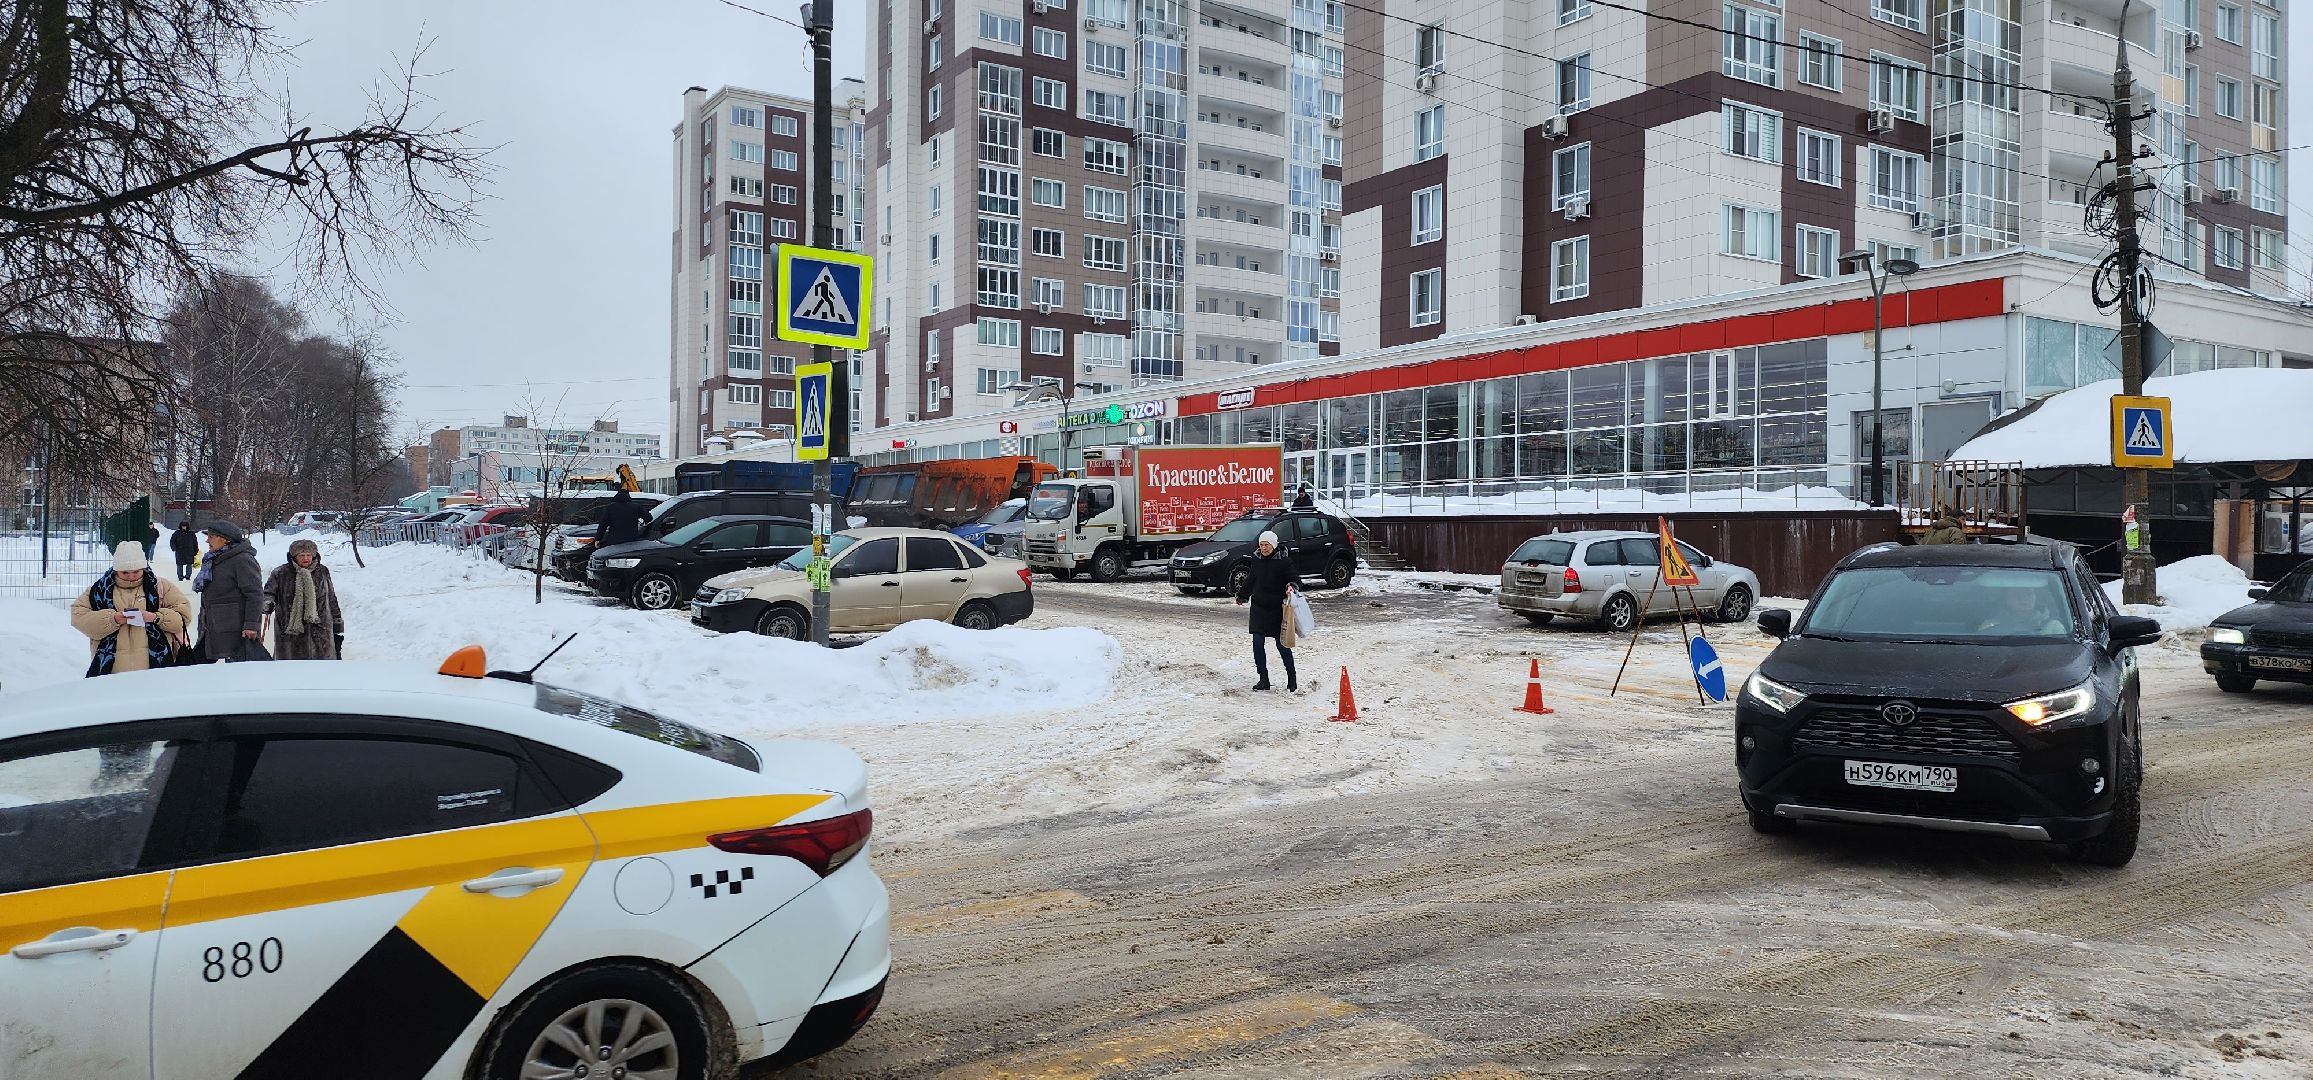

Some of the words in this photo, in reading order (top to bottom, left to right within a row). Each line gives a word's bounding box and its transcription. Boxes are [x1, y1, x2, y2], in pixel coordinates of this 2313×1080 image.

[1130, 400, 1166, 419] OZON
[1147, 462, 1274, 493] Красное&Белое
[1849, 763, 1921, 783] Н596КМ
[1924, 767, 1952, 780] 790
[203, 937, 282, 982] 880
